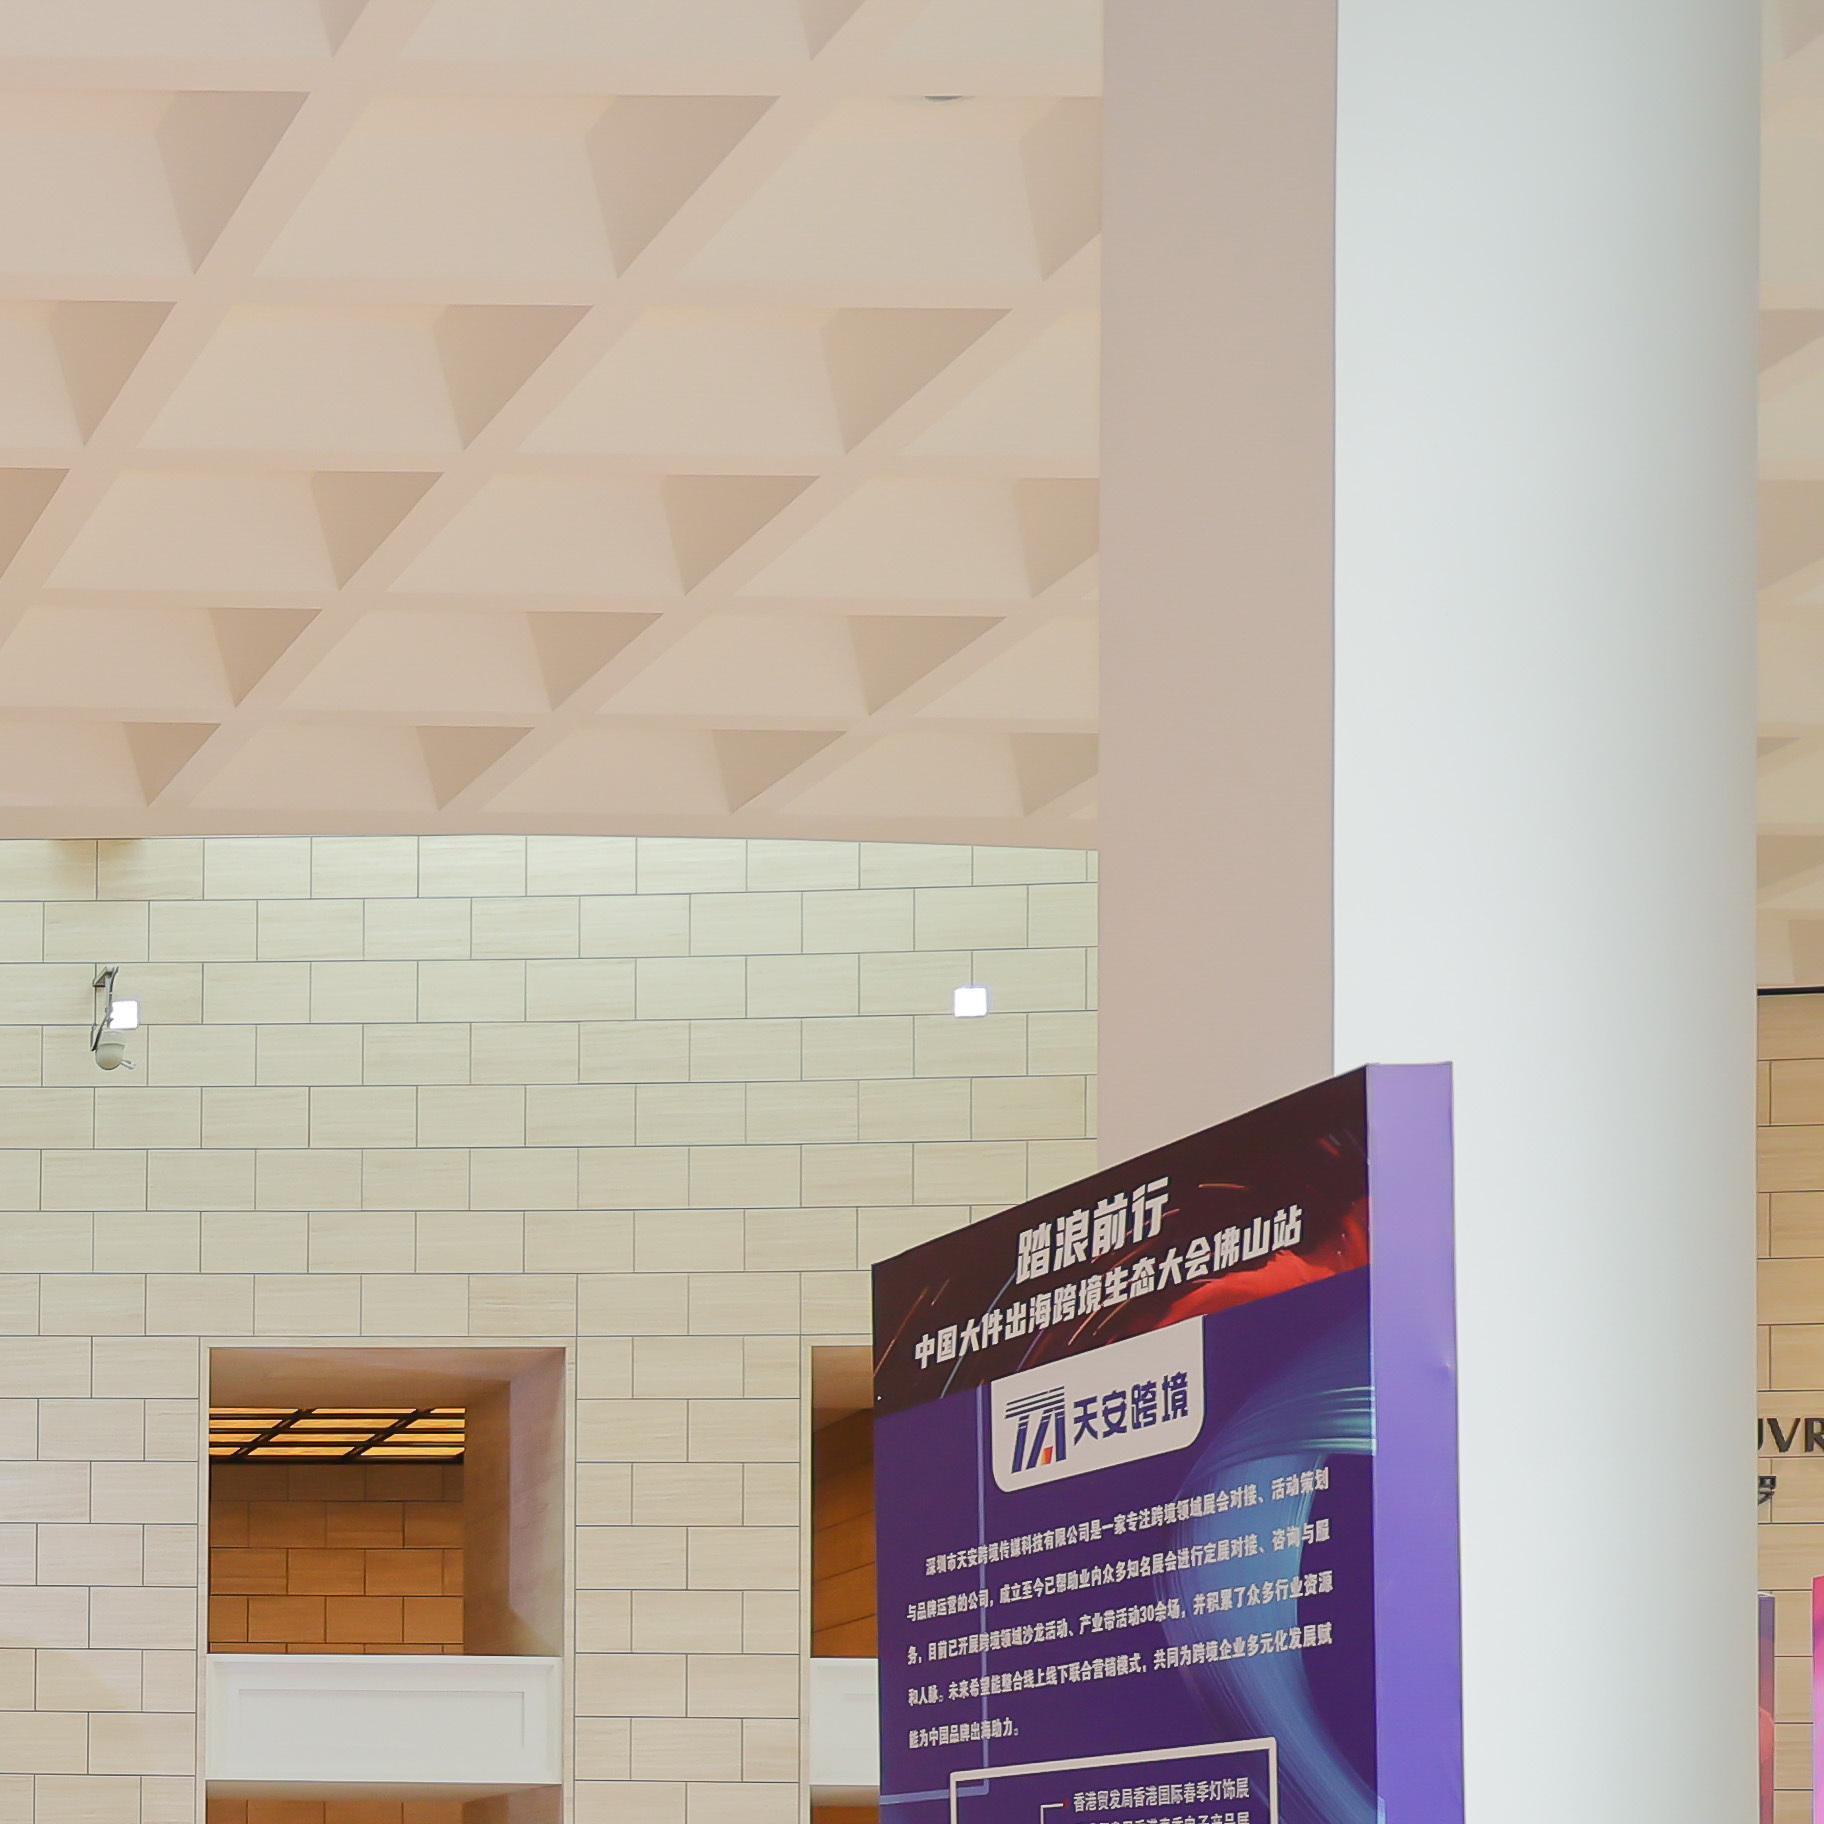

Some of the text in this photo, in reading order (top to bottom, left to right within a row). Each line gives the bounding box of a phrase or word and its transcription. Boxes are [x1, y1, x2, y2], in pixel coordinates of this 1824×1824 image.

[1016, 1176, 1172, 1285] 踏浪前行
[914, 1205, 1304, 1369] 中国大件出海跨境生态大会佛山站
[1072, 1370, 1191, 1448] 天安跨境
[1073, 1776, 1250, 1813] 香港贸发局香港国际春季灯饰展
